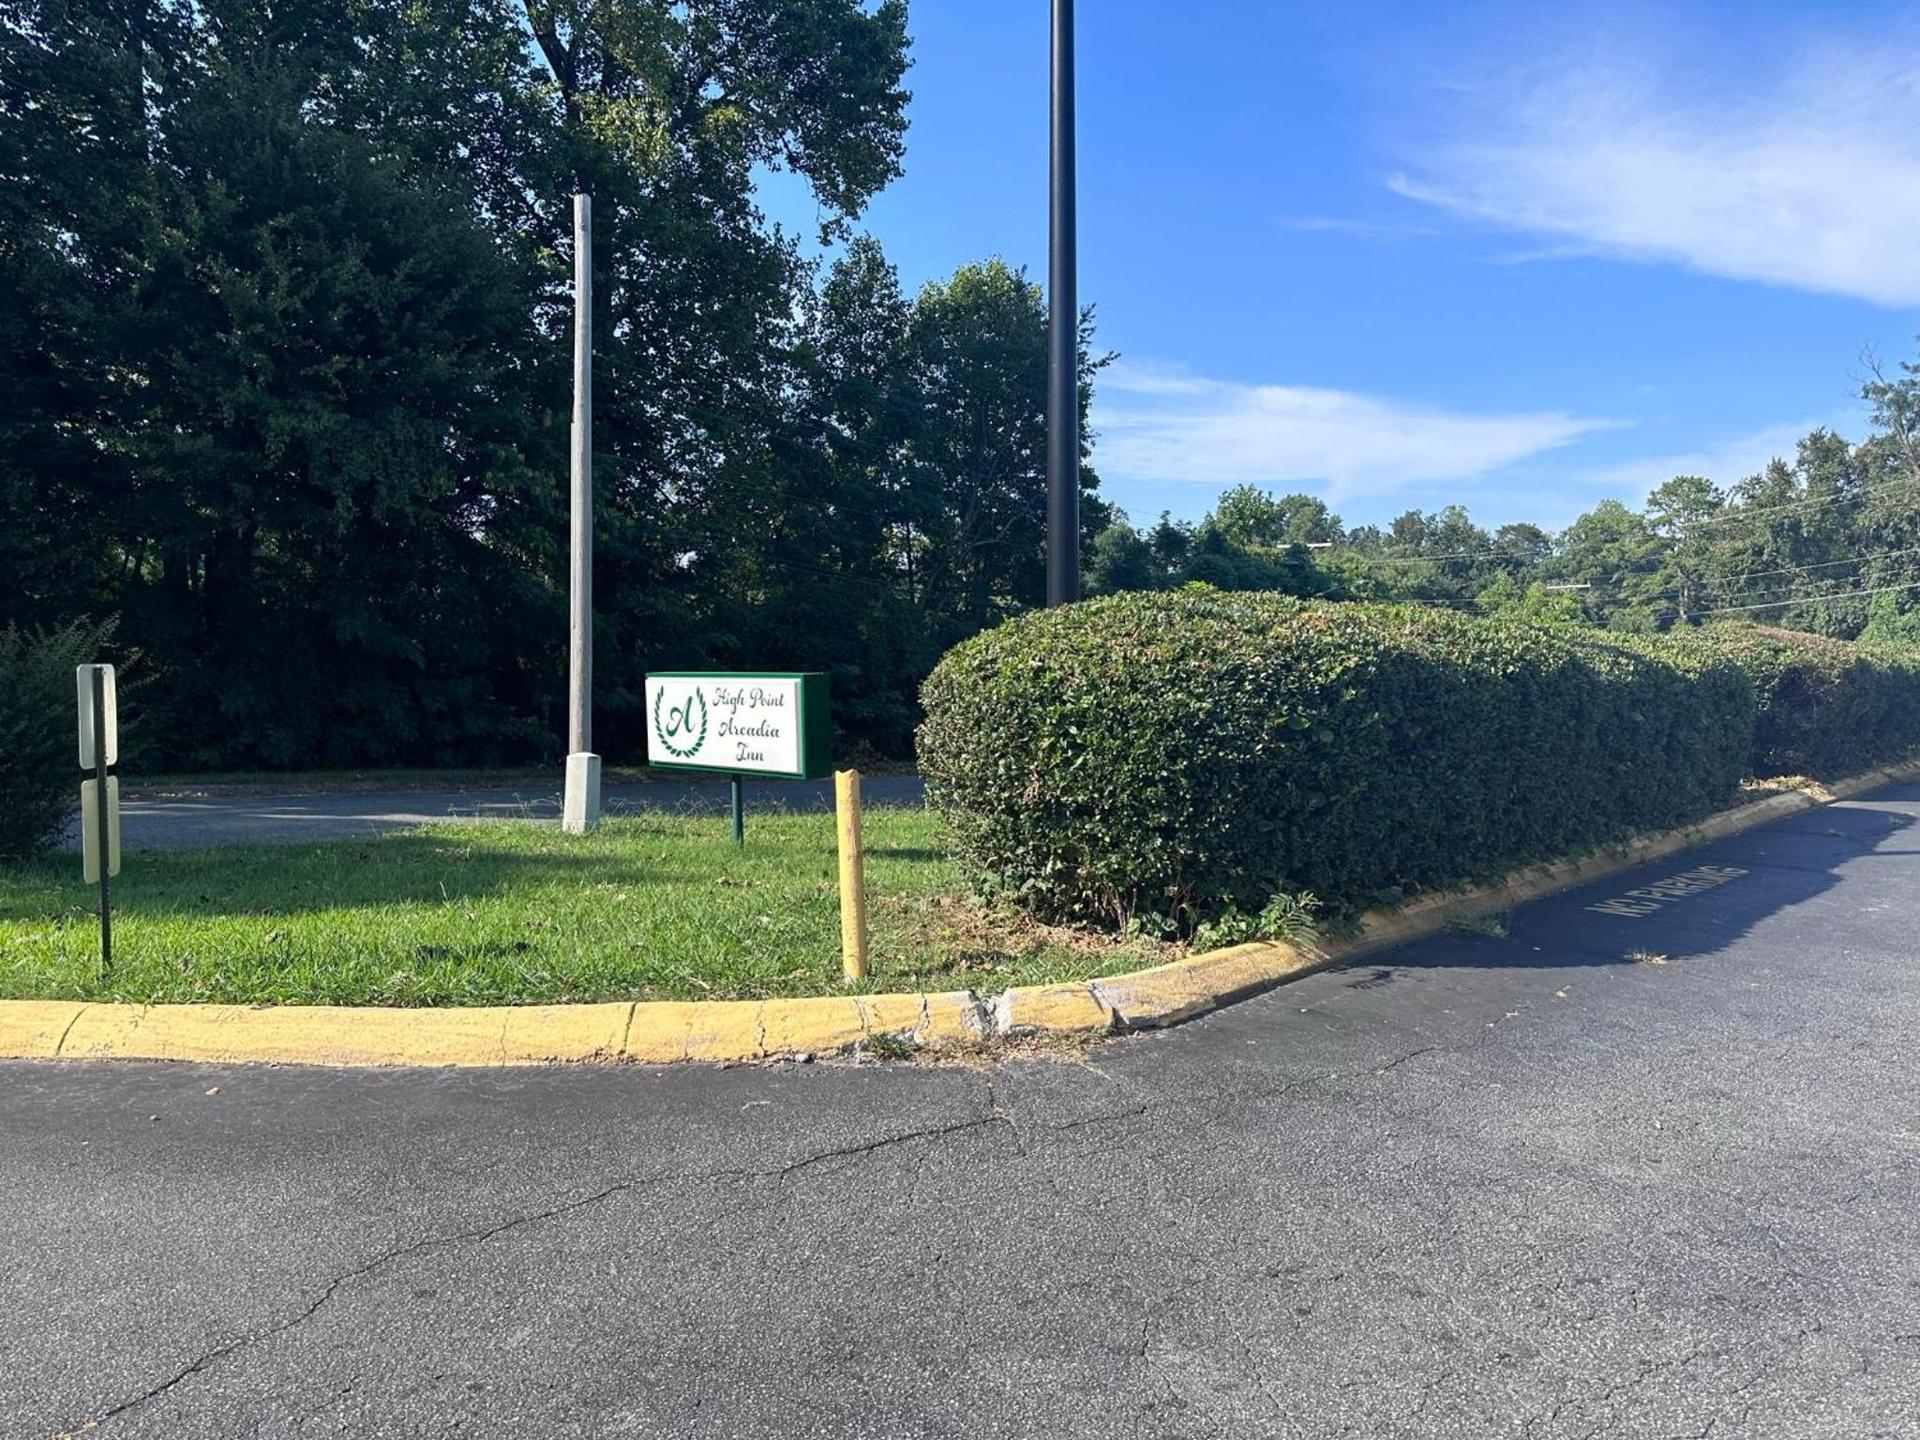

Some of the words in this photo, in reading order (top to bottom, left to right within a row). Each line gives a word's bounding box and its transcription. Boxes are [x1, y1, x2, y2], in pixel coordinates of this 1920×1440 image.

[712, 687, 745, 714] High
[749, 687, 785, 709] Point
[666, 695, 696, 737] A
[718, 717, 780, 738] Arcadia
[736, 741, 764, 762] Inn
[1584, 898, 1663, 918] NO
[1624, 865, 1750, 902] PARKING
